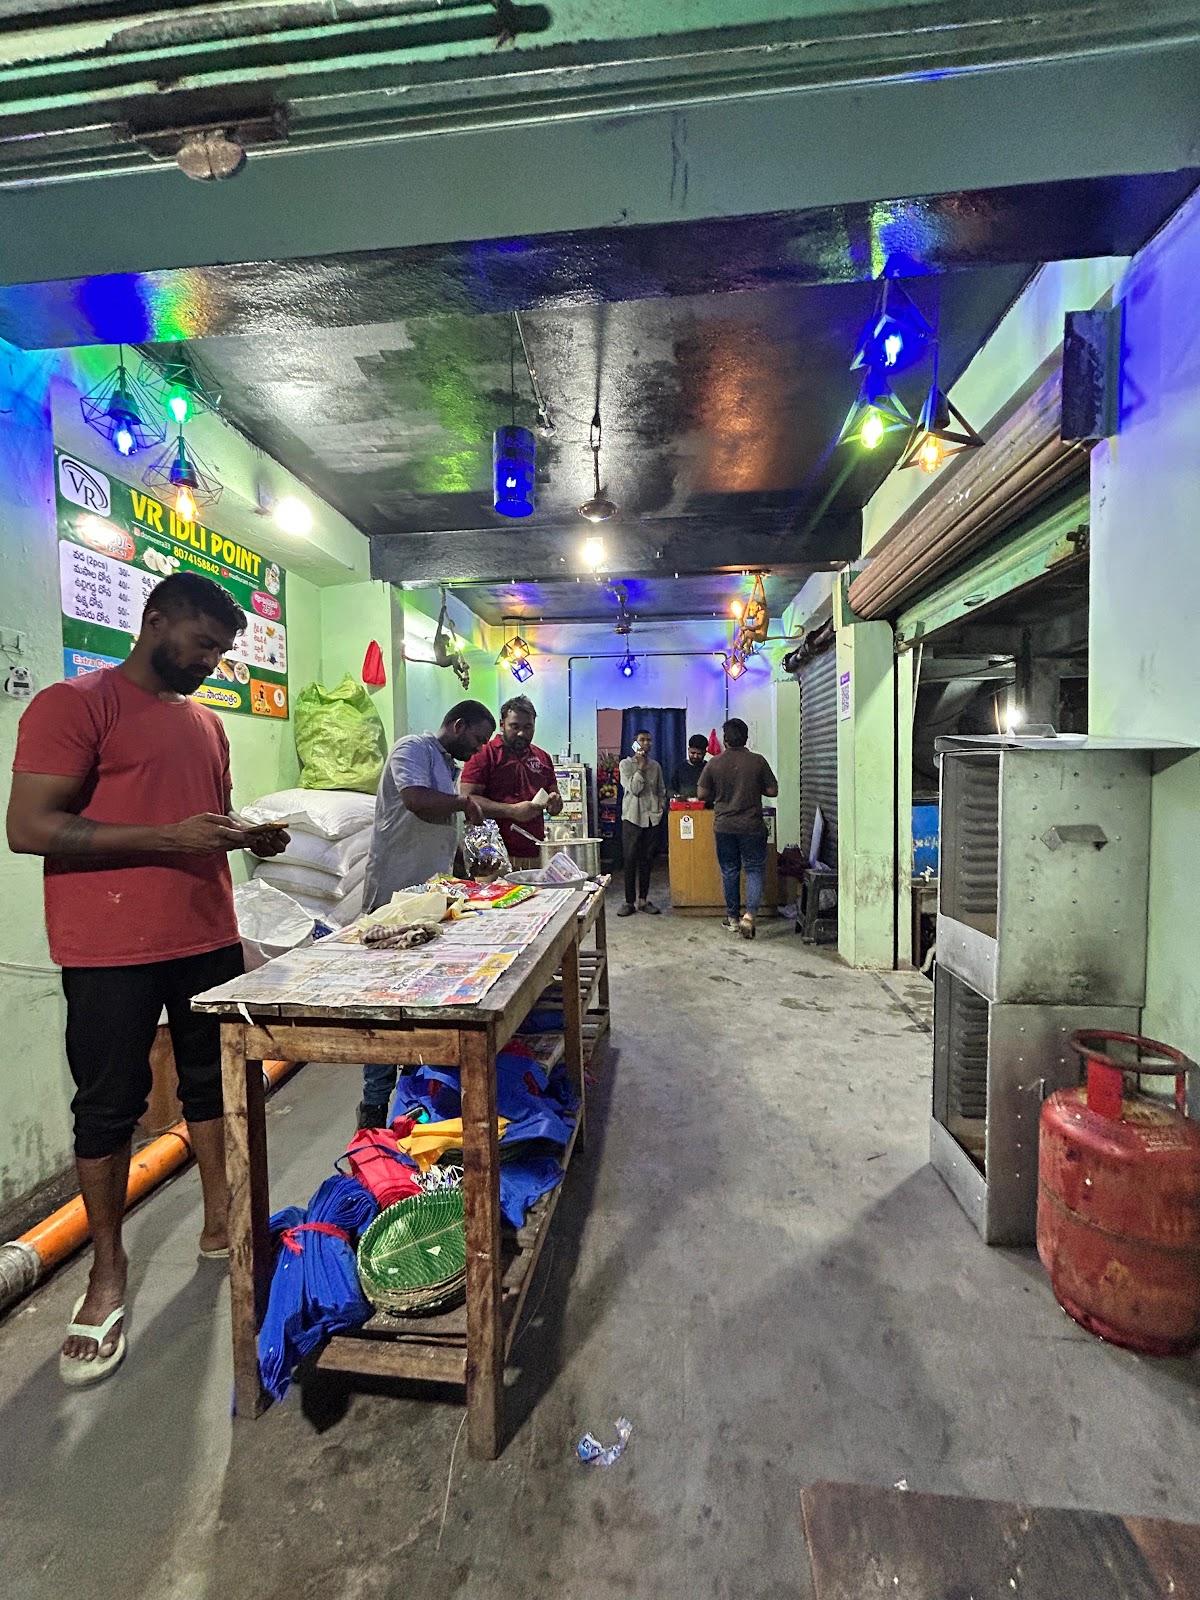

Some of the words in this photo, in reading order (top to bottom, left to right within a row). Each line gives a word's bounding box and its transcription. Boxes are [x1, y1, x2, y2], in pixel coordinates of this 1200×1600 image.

[68, 469, 100, 511] VR
[129, 489, 163, 533] VR
[169, 510, 206, 552] IDLI
[211, 532, 261, 577] POINT
[86, 555, 109, 572] (2pcs)
